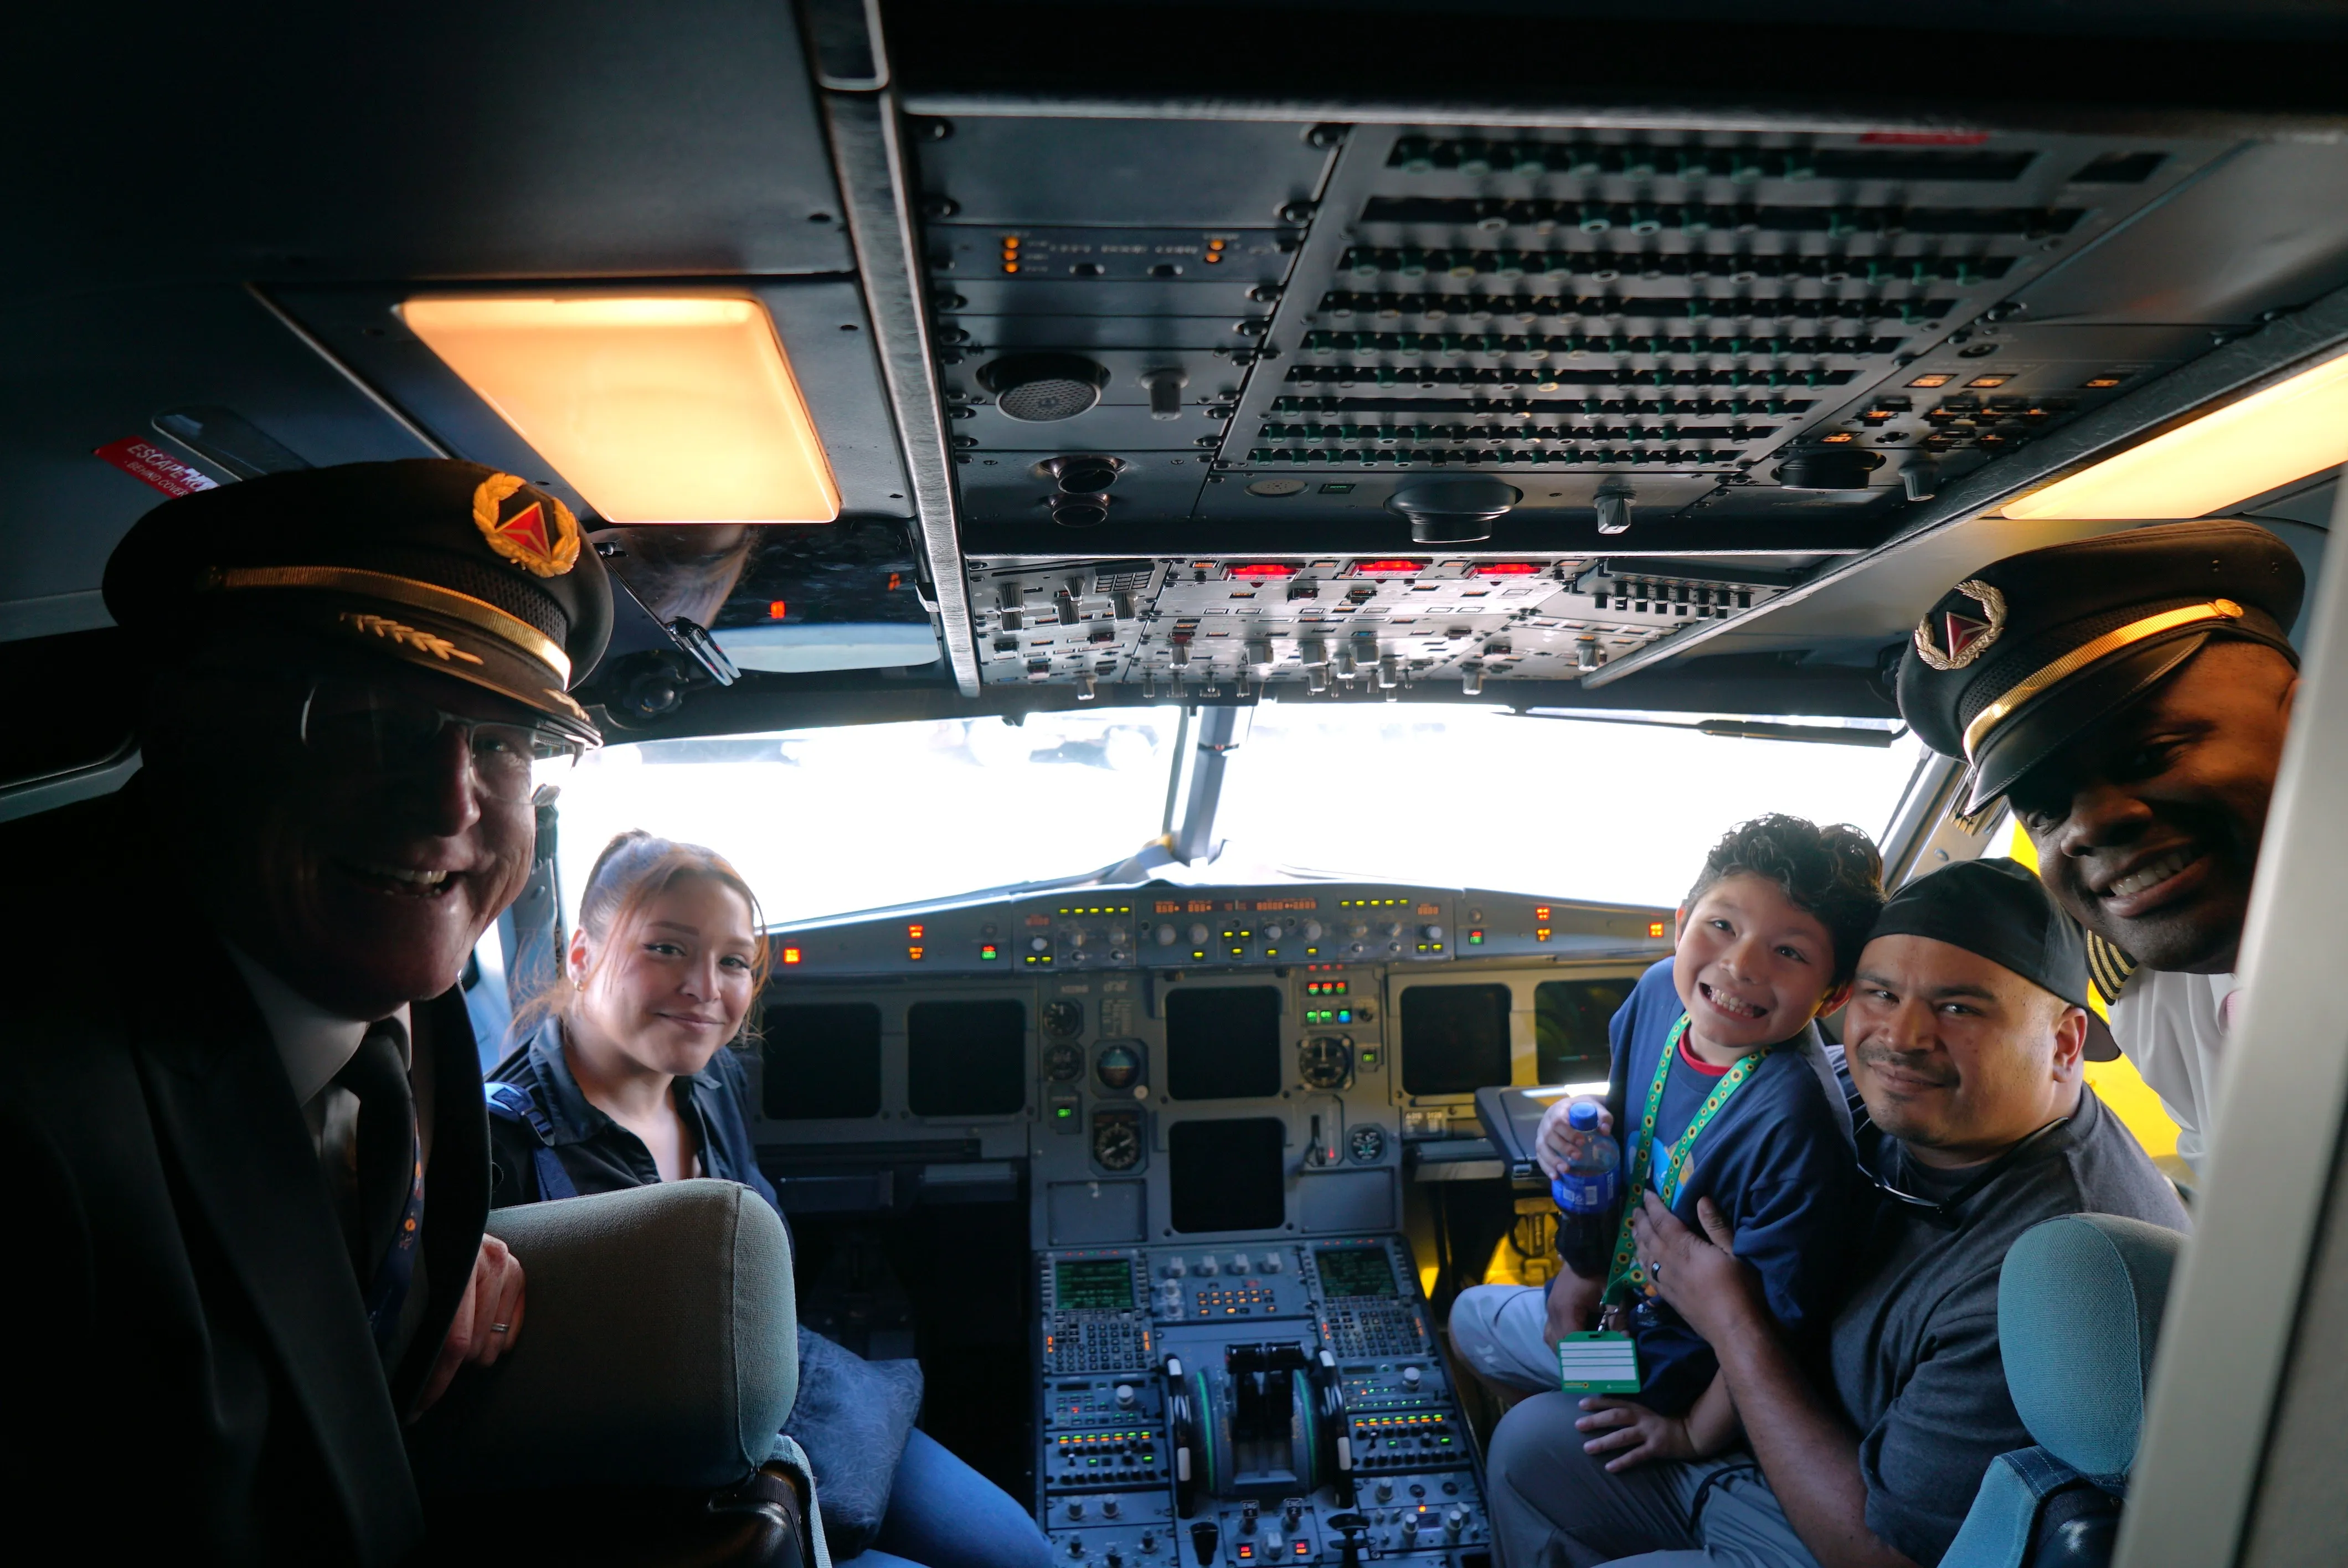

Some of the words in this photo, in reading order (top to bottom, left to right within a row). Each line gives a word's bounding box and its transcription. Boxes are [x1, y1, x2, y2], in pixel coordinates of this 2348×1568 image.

[127, 443, 184, 478] ESCAPE
[127, 461, 162, 482] BEHIND
[158, 479, 189, 497] COVER
